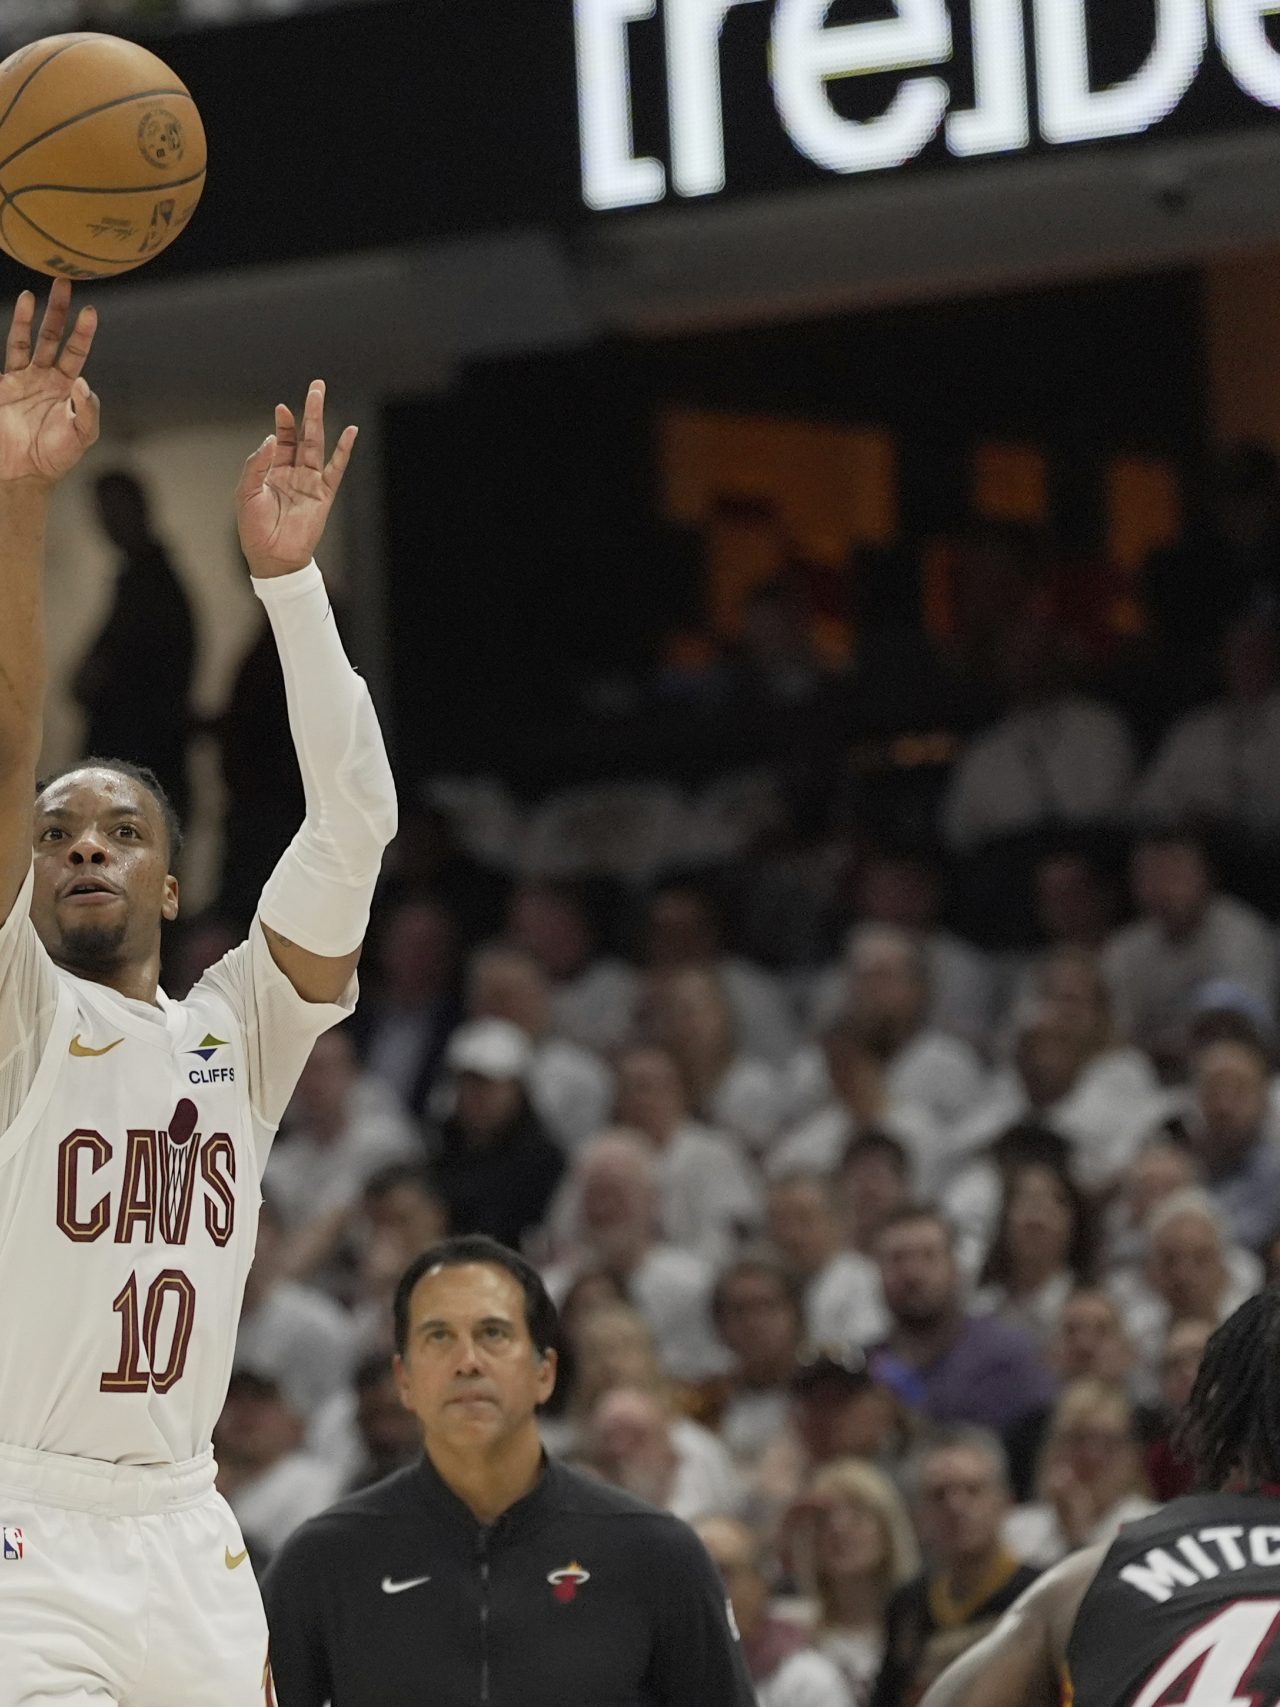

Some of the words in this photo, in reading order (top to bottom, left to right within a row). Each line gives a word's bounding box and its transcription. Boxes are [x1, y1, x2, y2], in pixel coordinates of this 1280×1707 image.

[188, 1067, 235, 1085] CLIFFS
[56, 1127, 237, 1248] CAVS
[99, 1268, 196, 1395] 10
